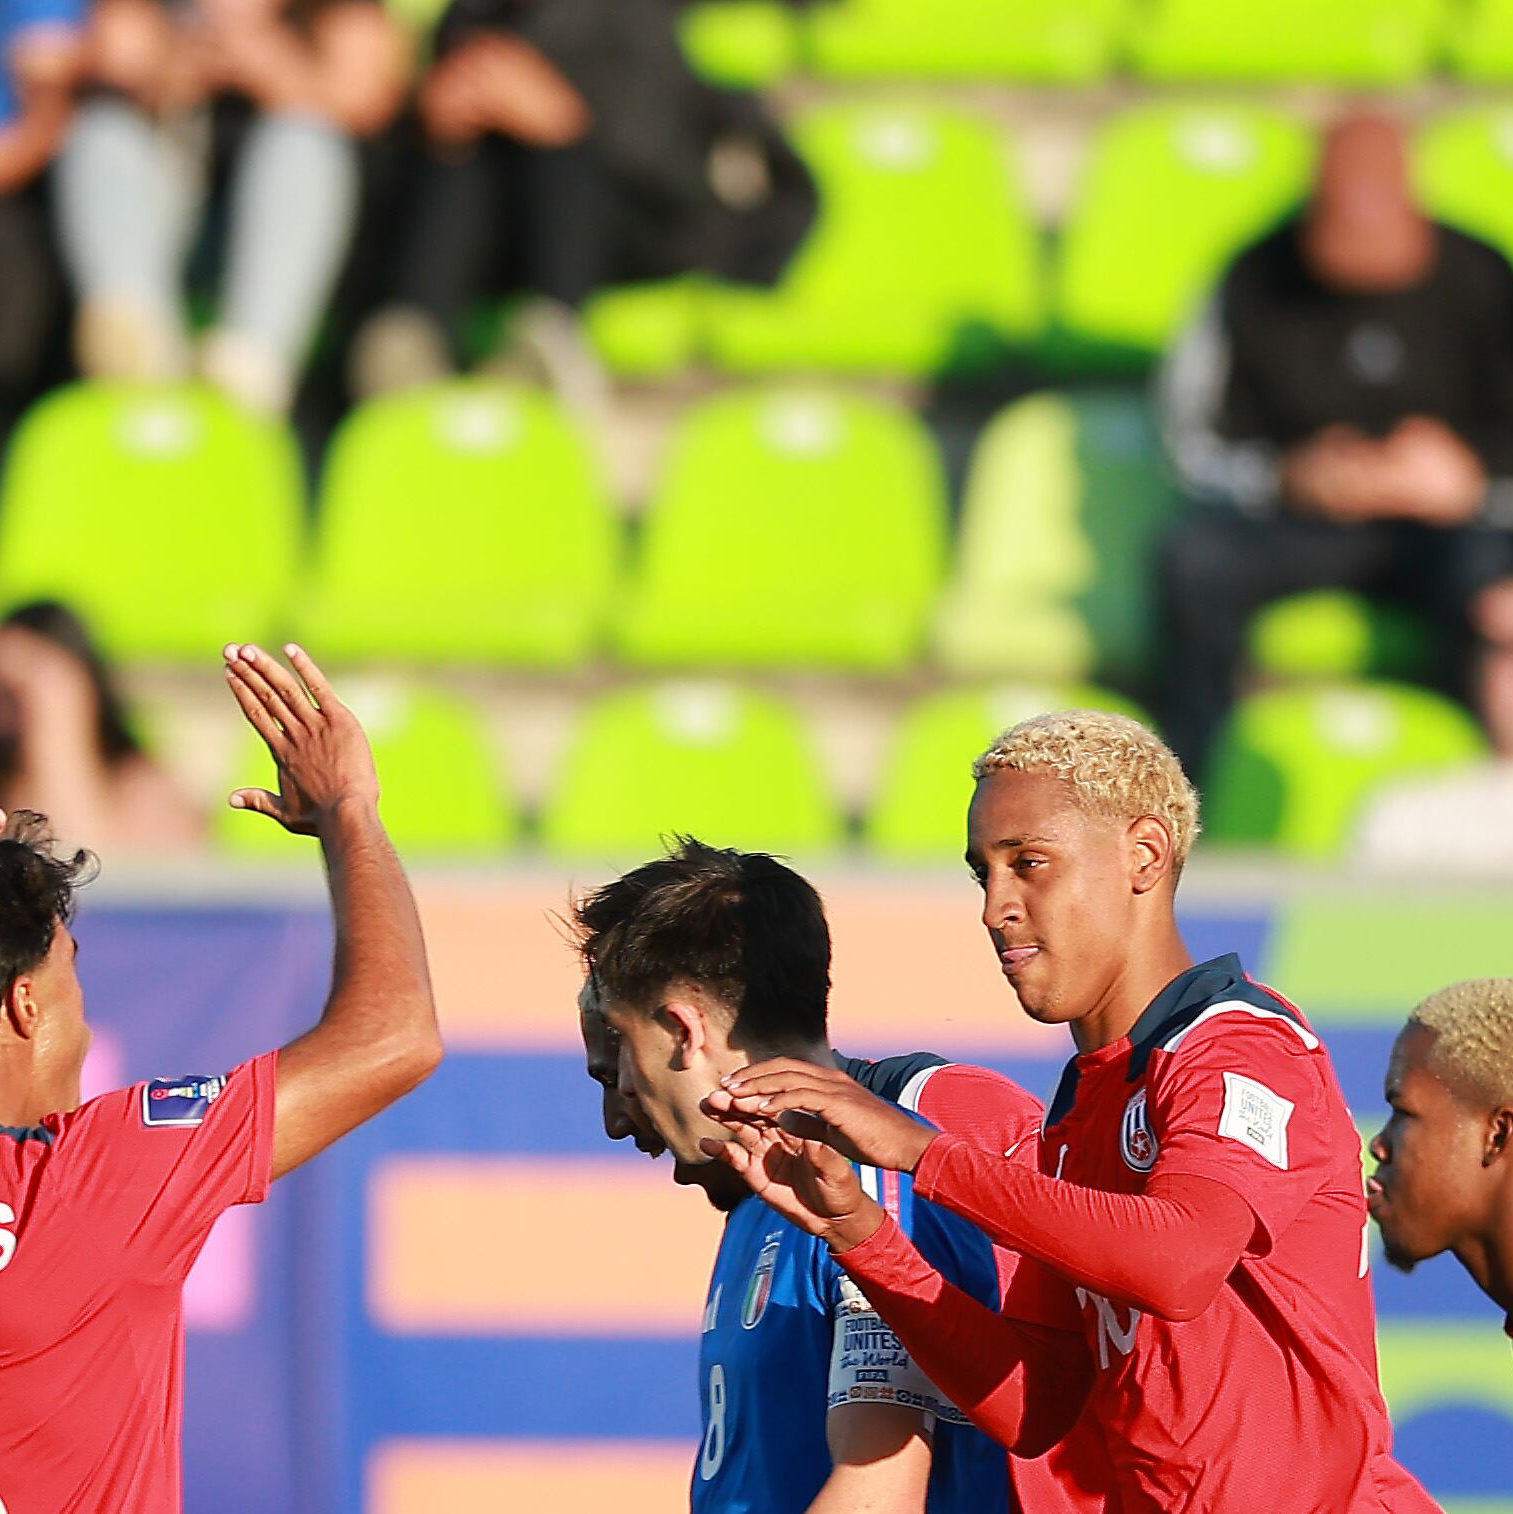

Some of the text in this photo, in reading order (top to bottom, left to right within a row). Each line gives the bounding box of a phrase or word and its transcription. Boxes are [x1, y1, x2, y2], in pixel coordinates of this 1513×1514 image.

[842, 1331, 904, 1351] UNITES
[862, 1350, 909, 1370] World
[858, 1370, 887, 1381] FIFA
[701, 1363, 727, 1482] 8
